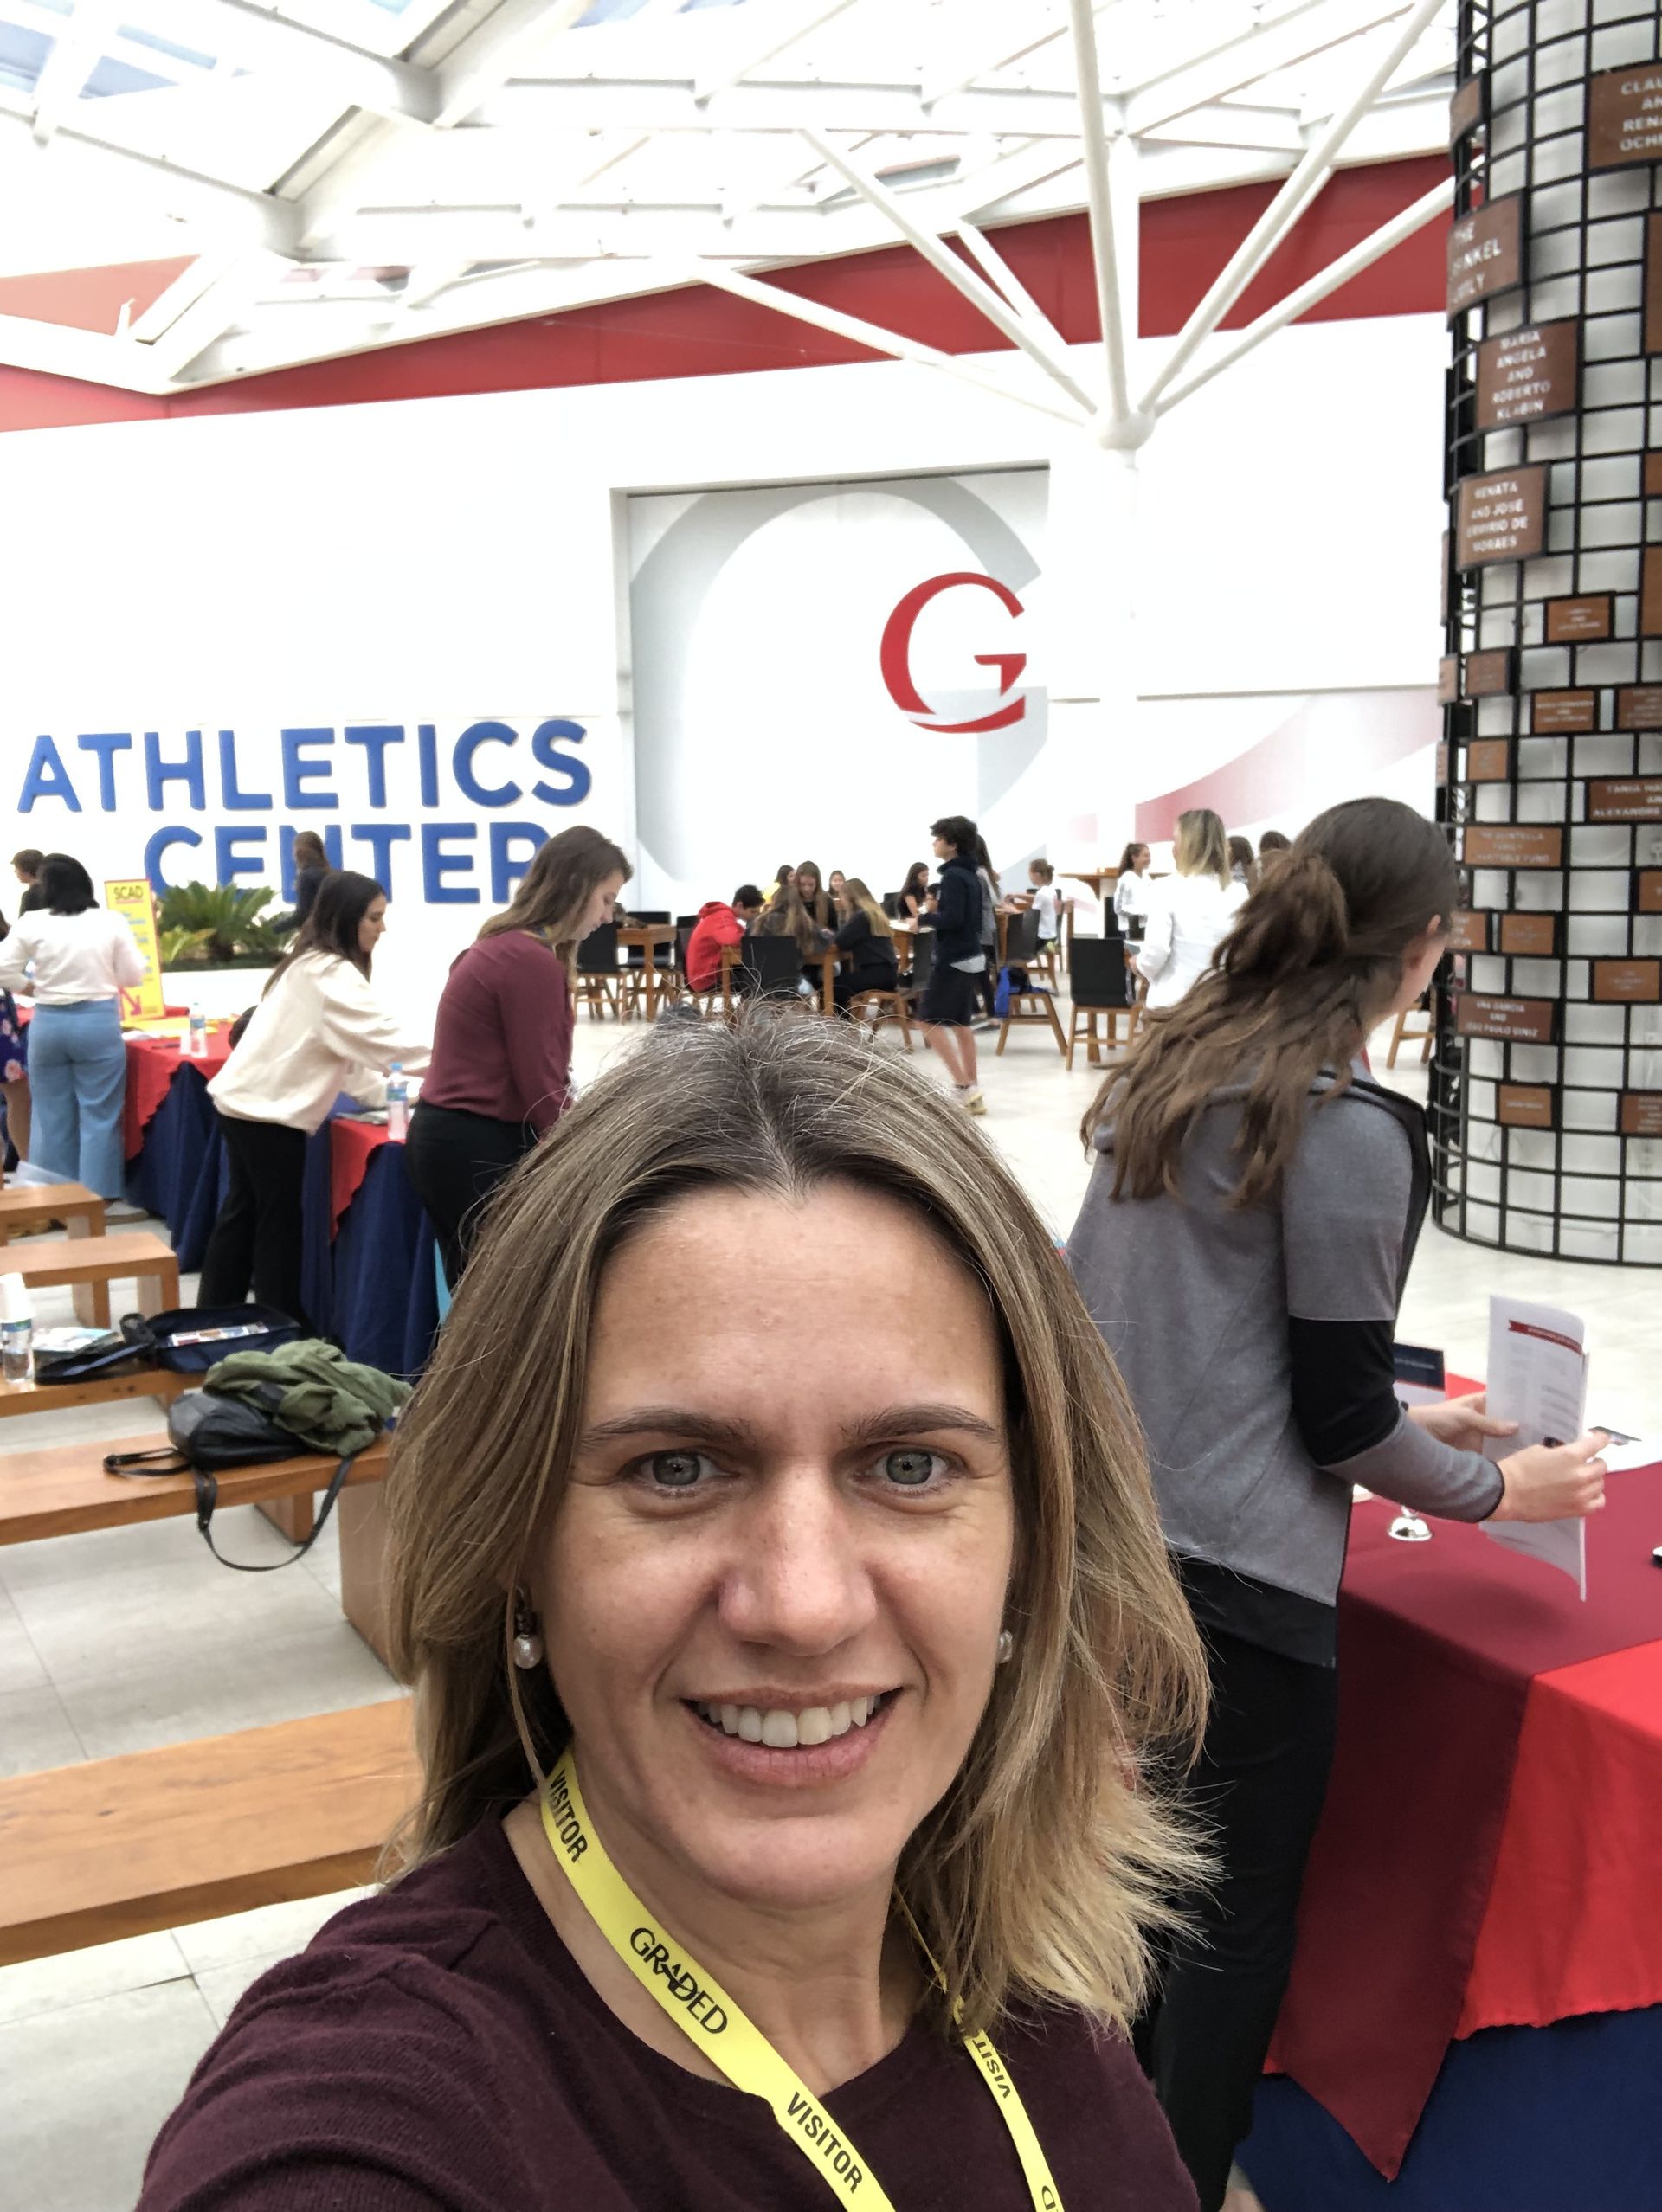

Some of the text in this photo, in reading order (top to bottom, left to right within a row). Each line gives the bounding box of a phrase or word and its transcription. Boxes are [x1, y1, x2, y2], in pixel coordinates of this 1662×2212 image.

[1622, 115, 1662, 132] REN
[880, 572, 1027, 734] G
[17, 720, 592, 813] ATHLETICS
[113, 885, 144, 900] SCAD
[549, 1770, 589, 1864] VISITOR
[629, 1926, 729, 2035] GRADED
[786, 2092, 864, 2194] VISITOR
